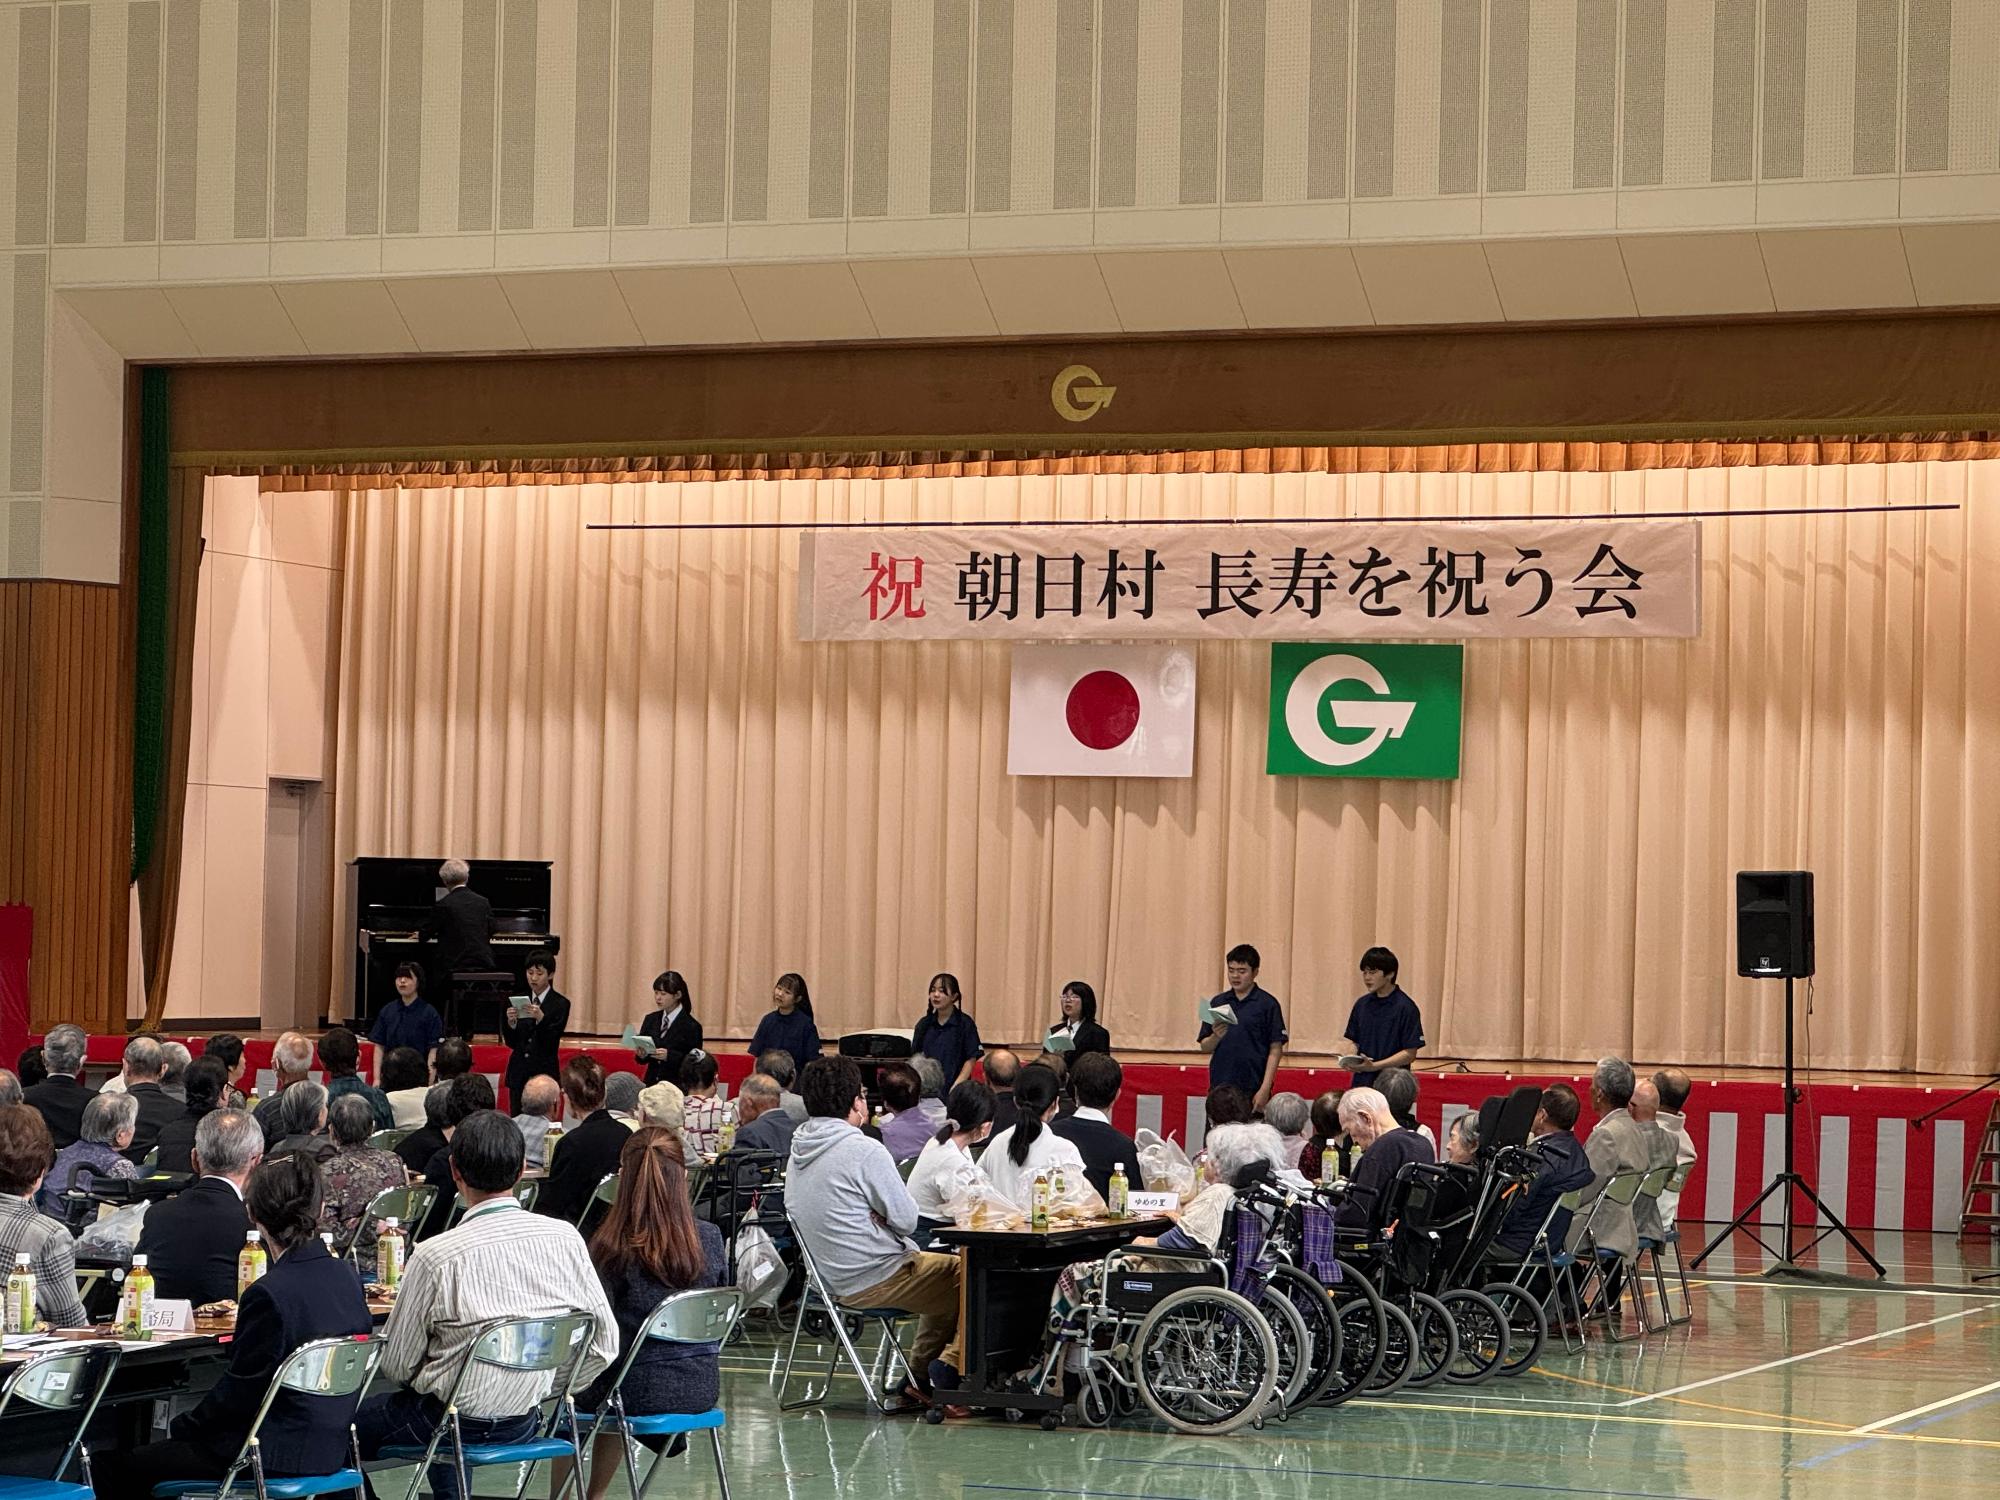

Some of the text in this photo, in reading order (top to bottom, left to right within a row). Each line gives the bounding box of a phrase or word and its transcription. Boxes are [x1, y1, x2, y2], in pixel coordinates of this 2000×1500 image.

[861, 543, 1644, 621] 祝 朝日村 長寿を祝う会
[1134, 1197, 1166, 1207] ゆめの里
